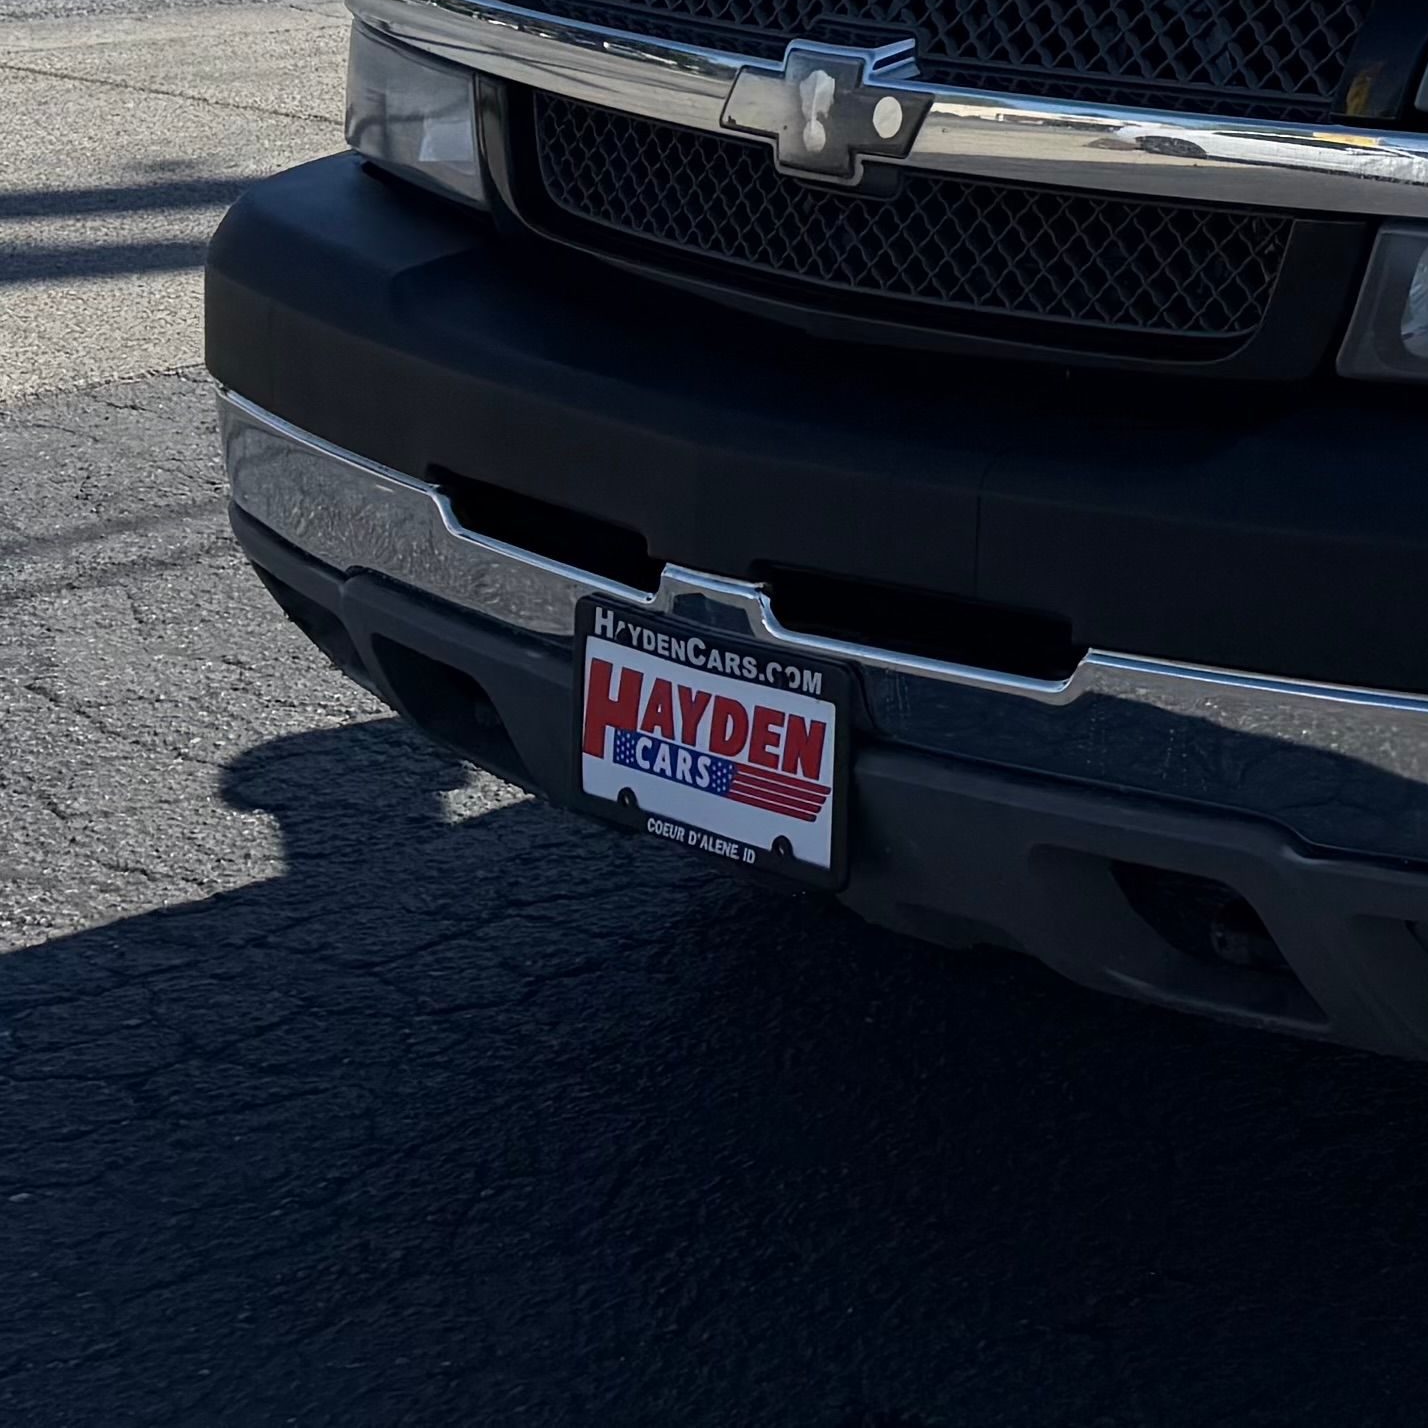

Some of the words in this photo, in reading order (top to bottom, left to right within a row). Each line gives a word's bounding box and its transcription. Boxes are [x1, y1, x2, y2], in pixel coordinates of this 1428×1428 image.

[582, 657, 828, 782] HAYDEN
[635, 735, 713, 789] CARS
[646, 817, 686, 843] COEUR
[742, 847, 757, 865] ID
